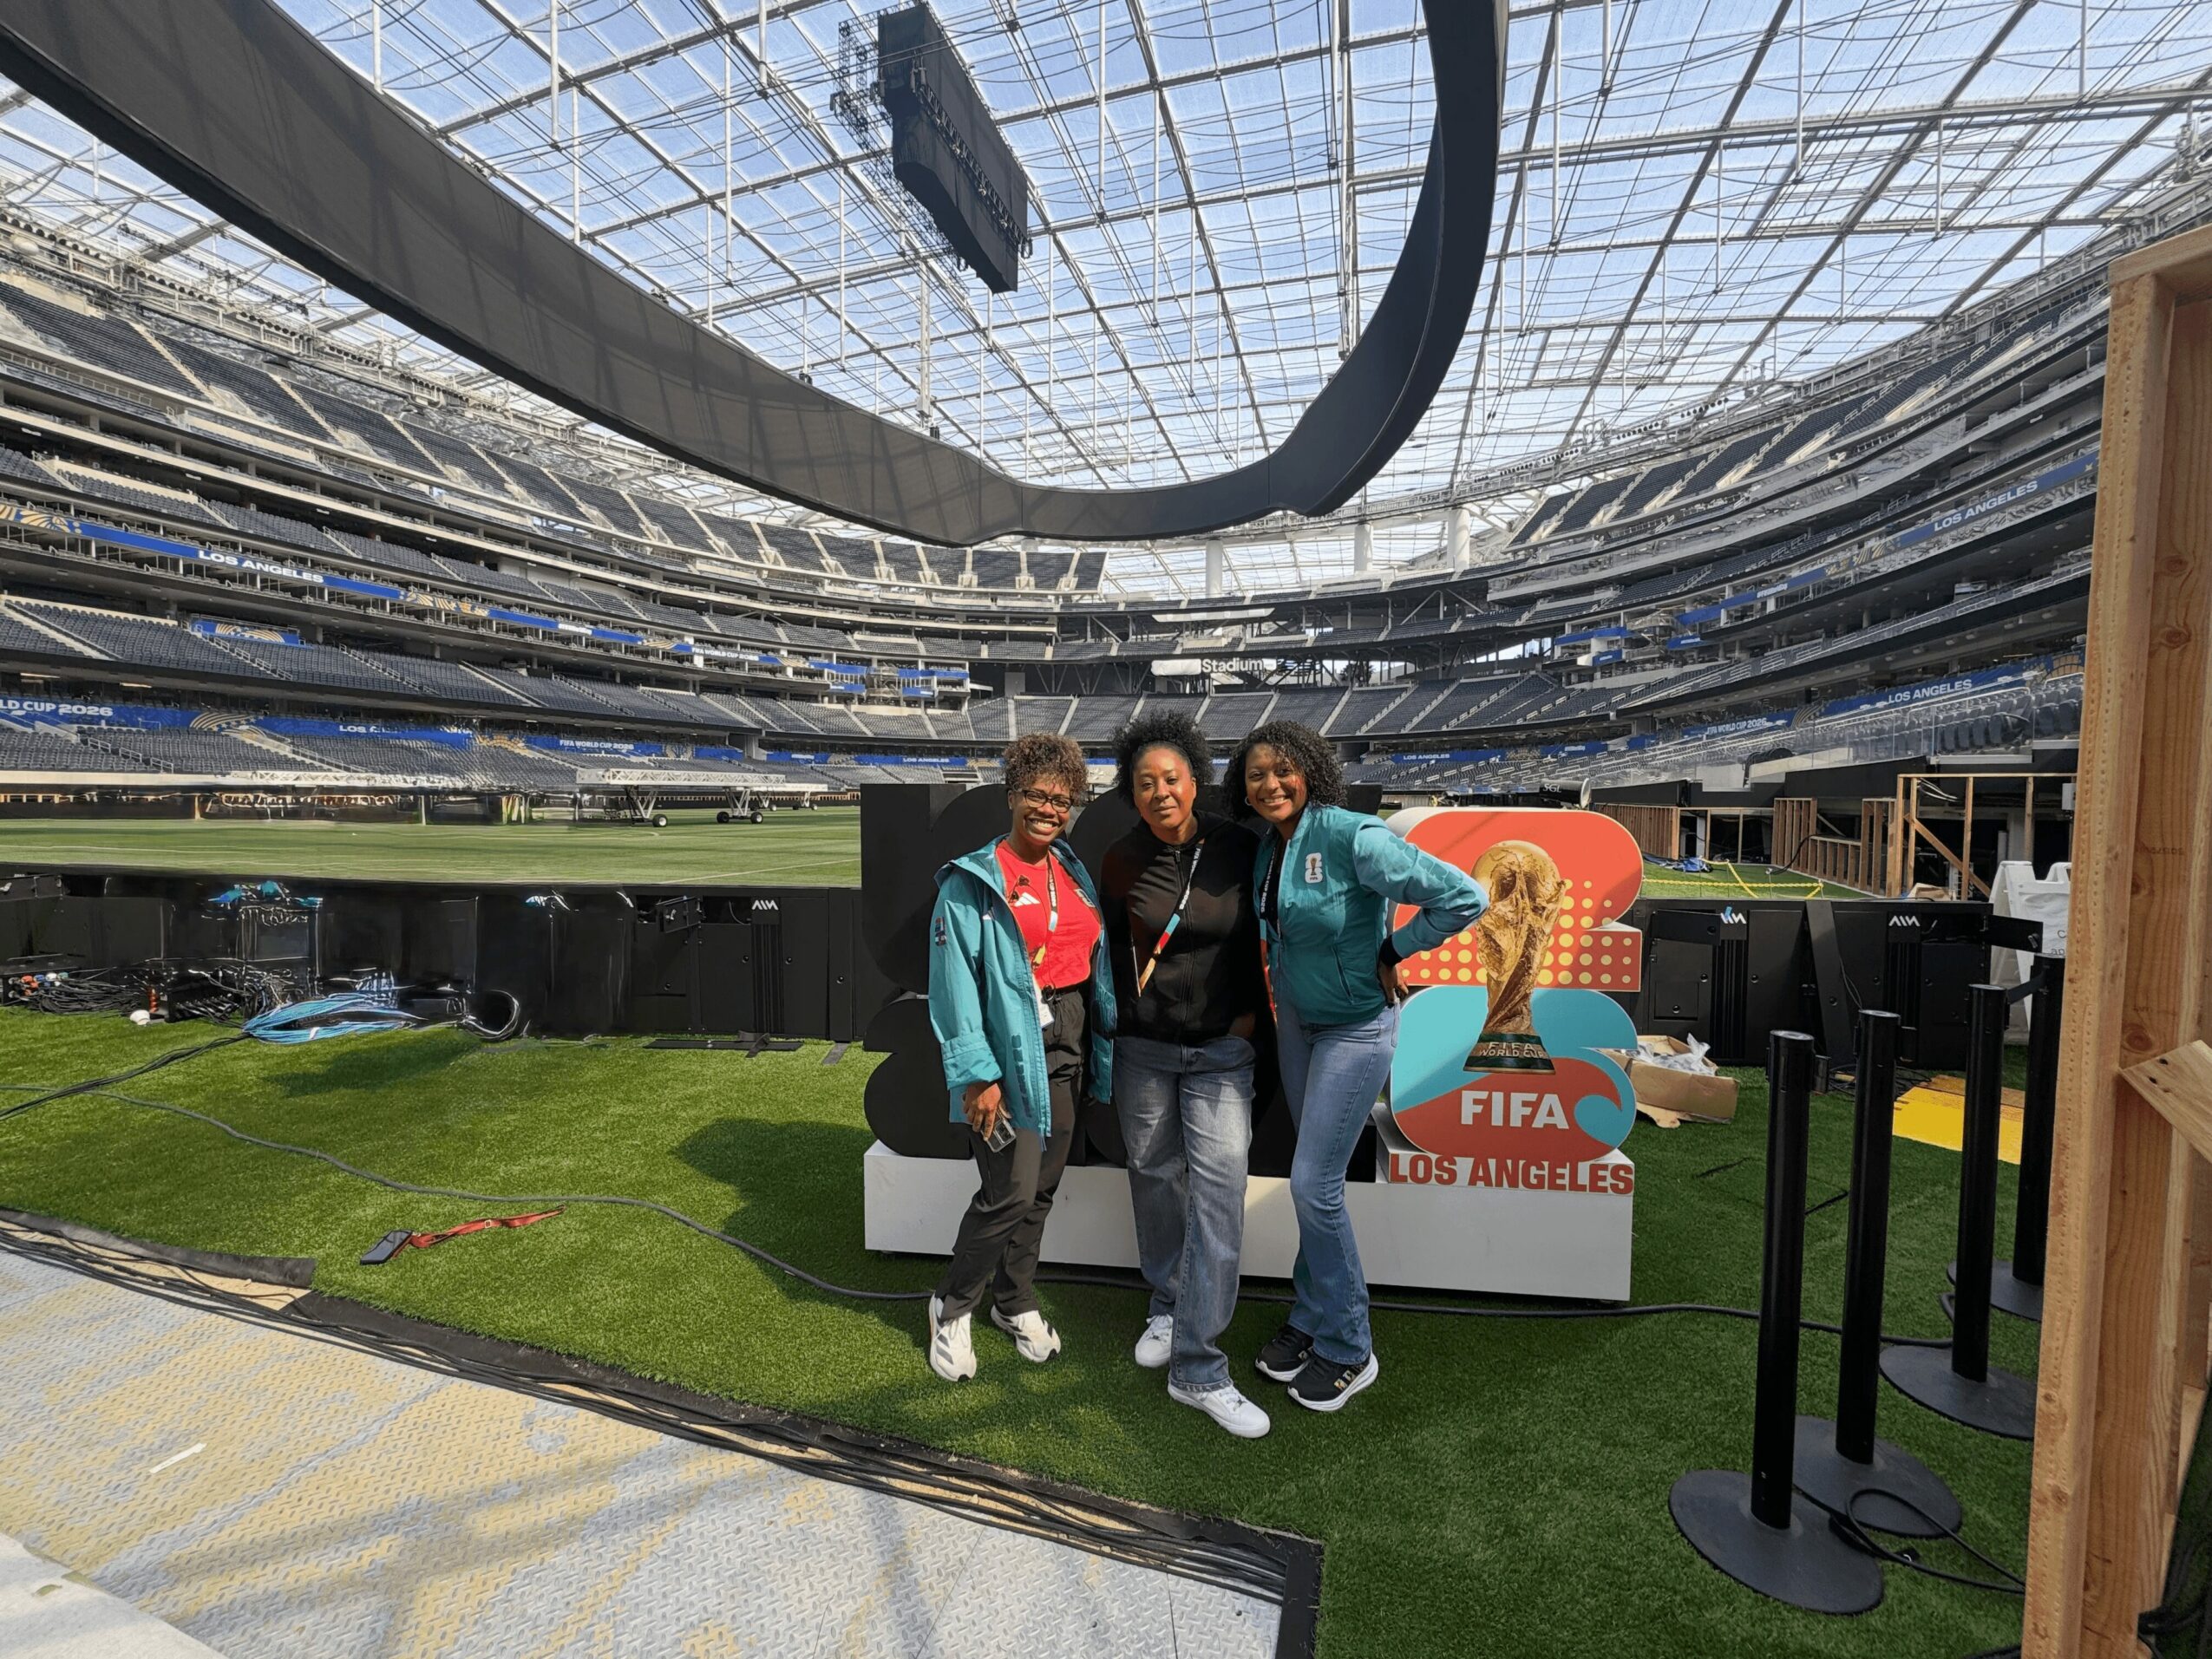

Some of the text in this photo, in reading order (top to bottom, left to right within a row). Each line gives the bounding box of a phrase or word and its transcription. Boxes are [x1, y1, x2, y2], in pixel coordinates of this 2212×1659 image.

[1934, 480, 2039, 532] LOS ANGELES
[199, 550, 324, 584] LOS ANGELES
[704, 649, 727, 657] WORLD
[1201, 656, 1263, 673] Stadium
[1888, 678, 1973, 704] LOS ANGELES
[23, 701, 56, 713] CUP
[58, 703, 114, 716] 2026
[338, 725, 367, 734] LOS
[1718, 722, 1736, 733] WORLD
[1736, 721, 1747, 730] CUP
[1747, 717, 1767, 728] 2026
[574, 740, 599, 748] WORLD
[1542, 783, 1561, 794] SGL
[1488, 1042, 1535, 1050] FIFA
[1523, 1050, 1544, 1059] CUP
[1461, 1090, 1569, 1130] FIFA
[1390, 1153, 1634, 1195] LOS ANGELES
